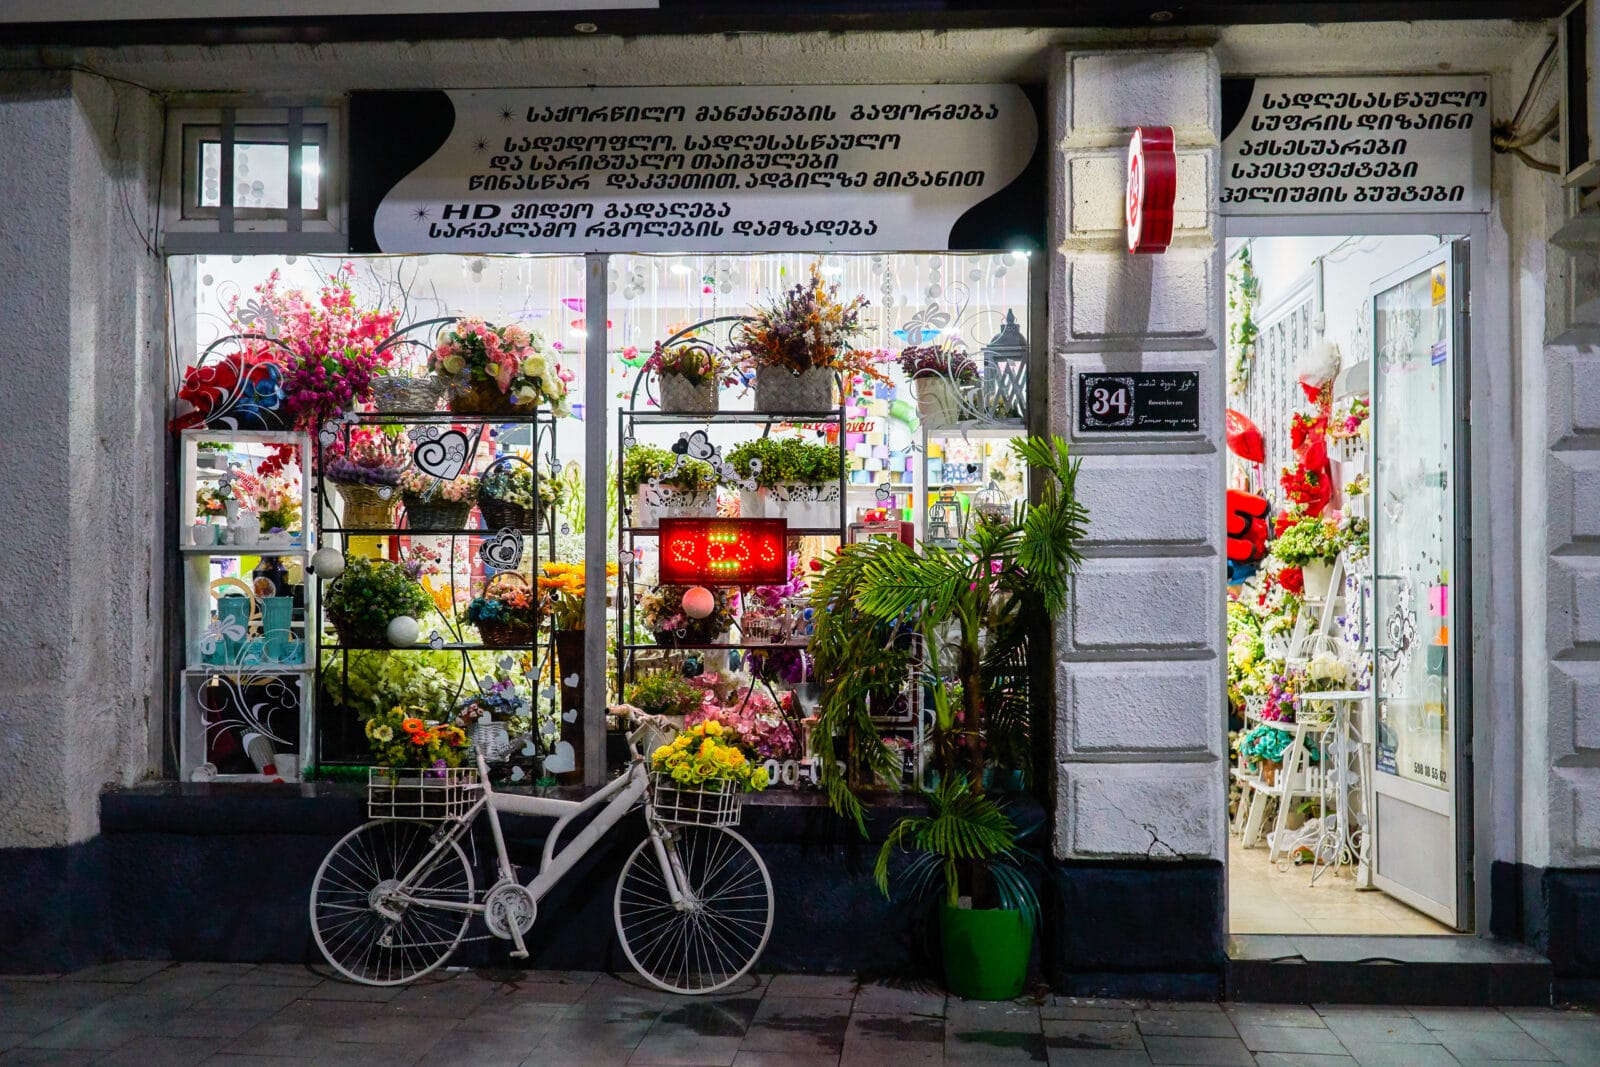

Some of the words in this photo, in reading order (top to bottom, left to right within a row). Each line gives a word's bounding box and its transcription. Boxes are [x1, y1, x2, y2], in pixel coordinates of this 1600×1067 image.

[1262, 91, 1488, 110] სადღესასწაულო
[527, 106, 685, 123] საქორწილო
[695, 105, 836, 122] მანქანების
[850, 104, 999, 121] გაფორმება
[1251, 115, 1353, 132] სუფრის
[1356, 113, 1474, 131] დიზაინი
[504, 136, 677, 153] სადედოფლო.
[684, 134, 901, 151] სადღესასწაულო
[1239, 139, 1407, 156] აქსესუარები
[489, 155, 523, 172] და
[530, 154, 685, 171] სარიტუალო
[691, 153, 839, 170] თაიგულები
[1231, 162, 1419, 179] სპეცეფექტები
[469, 174, 590, 191] წინასწარ
[745, 172, 868, 189] ადგილზე
[873, 171, 985, 187] მიტანით
[1219, 186, 1348, 203] ჰელიუმის
[1354, 185, 1464, 203] ბუშტები
[442, 204, 501, 220] HD
[511, 203, 593, 220] ვიდეო
[604, 202, 731, 219] გადაღება
[429, 222, 577, 239] სარეკლამო
[585, 221, 723, 238] რგოლების
[732, 220, 877, 237] დამზადება
[1092, 388, 1127, 415] 34
